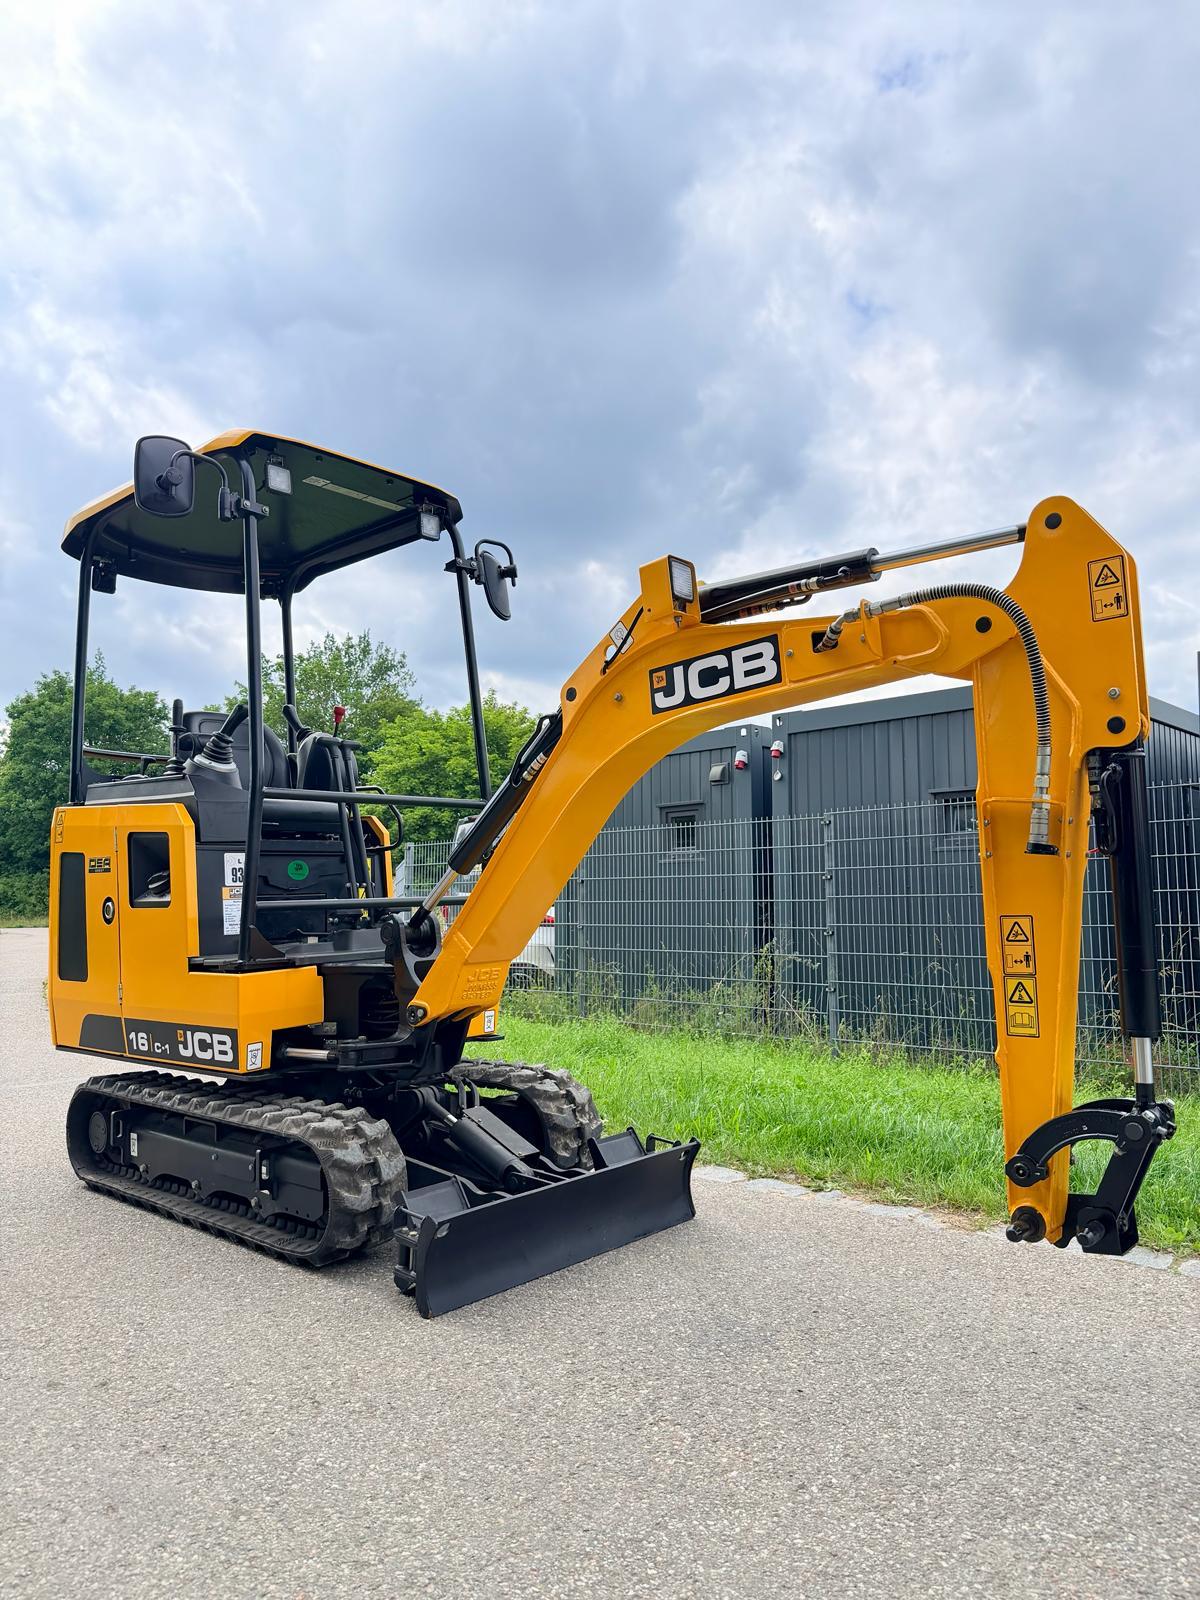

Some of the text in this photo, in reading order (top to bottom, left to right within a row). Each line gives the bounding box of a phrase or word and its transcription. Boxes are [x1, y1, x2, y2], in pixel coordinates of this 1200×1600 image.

[654, 641, 778, 709] JCB
[231, 867, 244, 883] 93
[129, 1031, 149, 1052] 16
[178, 1030, 234, 1063] JCB
